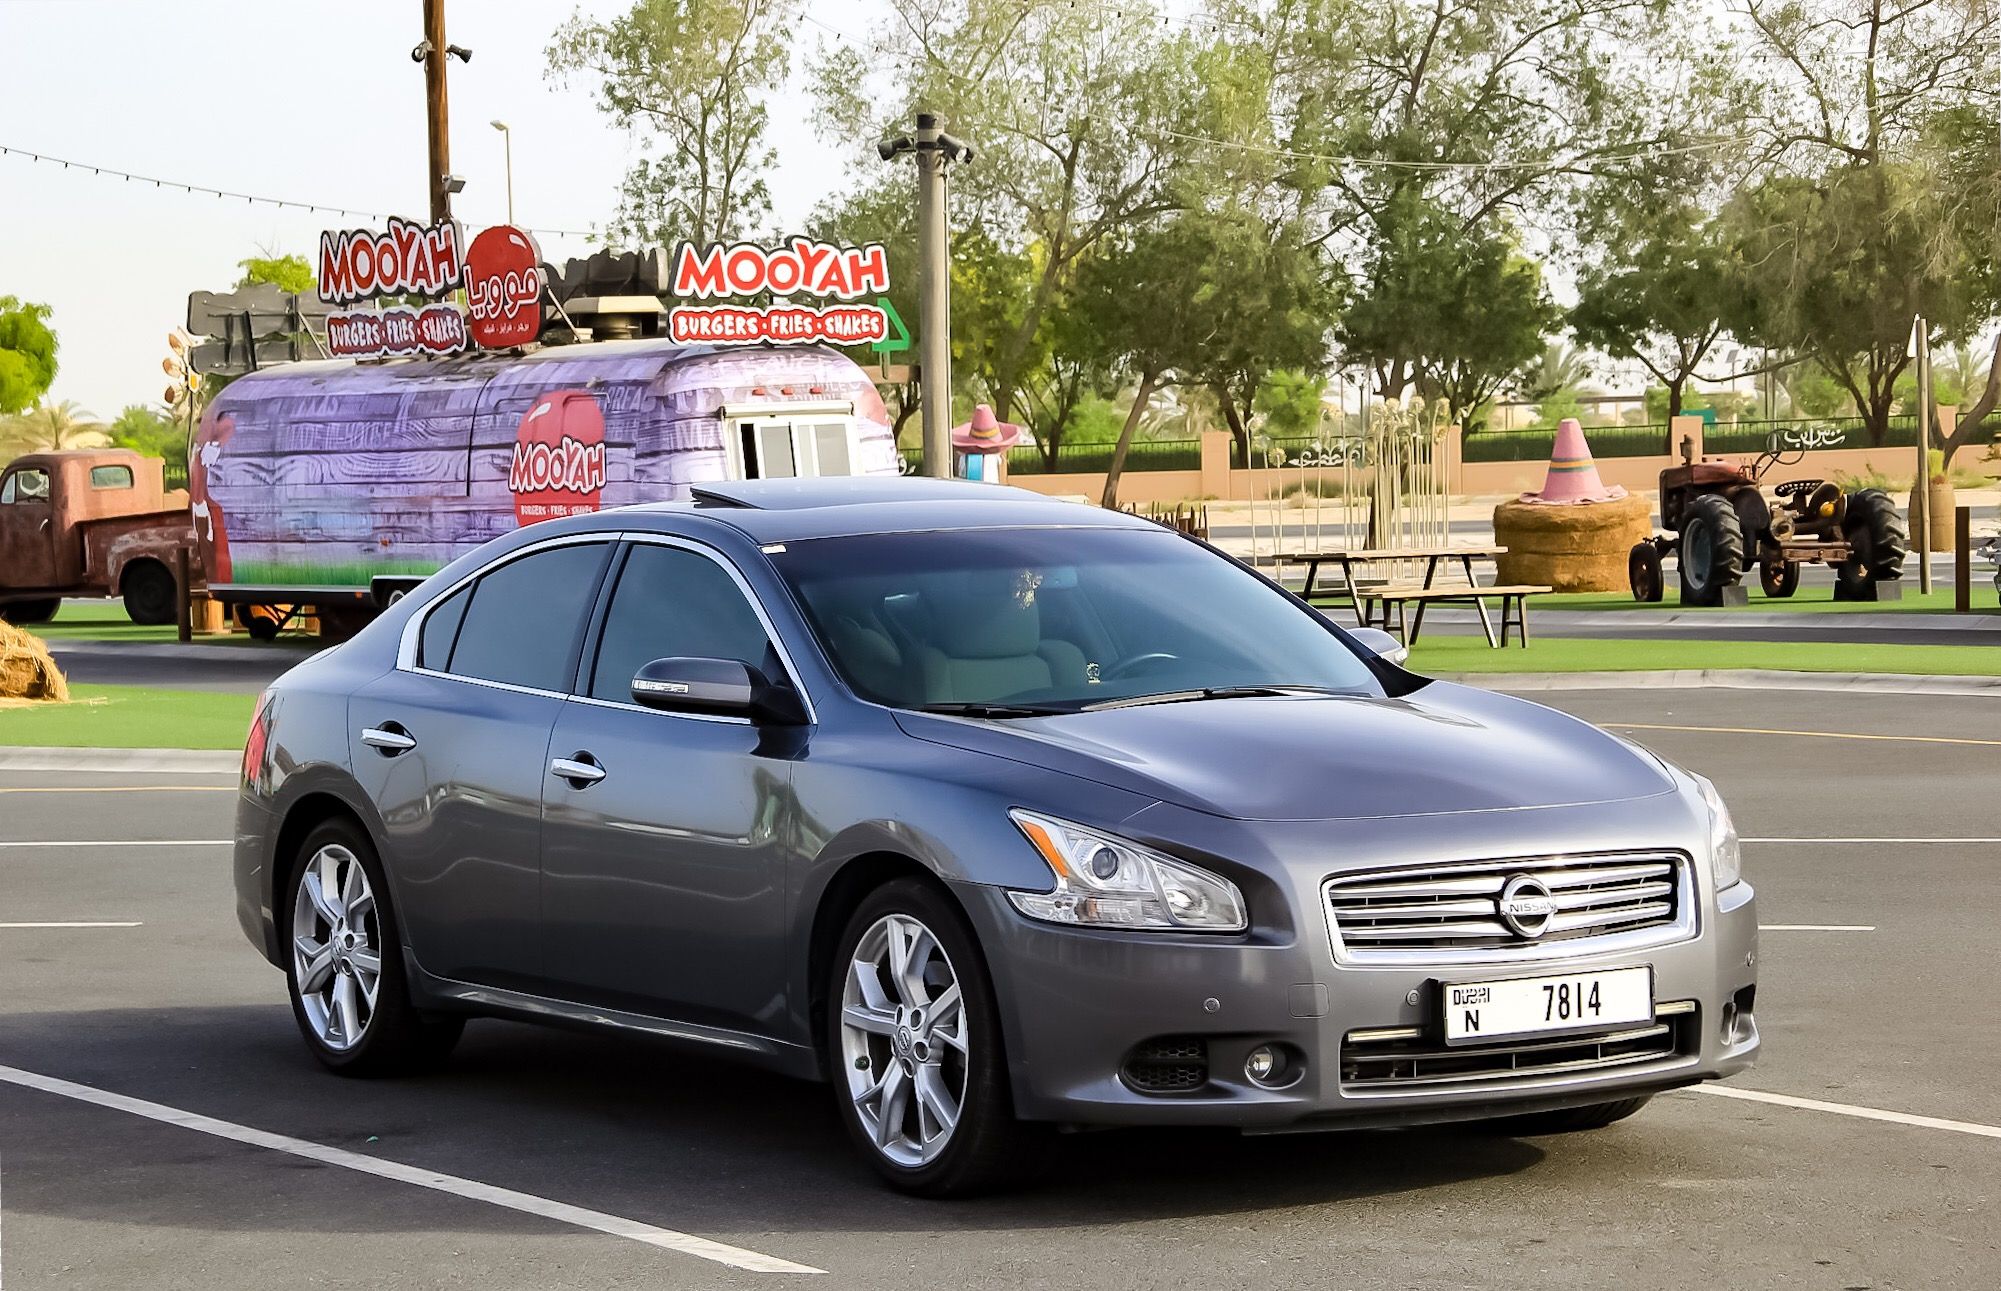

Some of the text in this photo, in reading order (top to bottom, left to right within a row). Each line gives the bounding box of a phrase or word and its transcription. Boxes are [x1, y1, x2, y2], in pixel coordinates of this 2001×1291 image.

[319, 219, 460, 300] MOOYAH
[674, 238, 889, 297] MOOYAH
[463, 265, 540, 319] موويا
[330, 315, 461, 348] BURGERS FRIES SHAKES
[677, 314, 880, 336] BURGERS FRIES SHAKES
[509, 436, 606, 493] MOOYAH
[1509, 902, 1554, 912] NISSAN
[1465, 1009, 1479, 1032] N
[1543, 981, 1602, 1021] 7814
